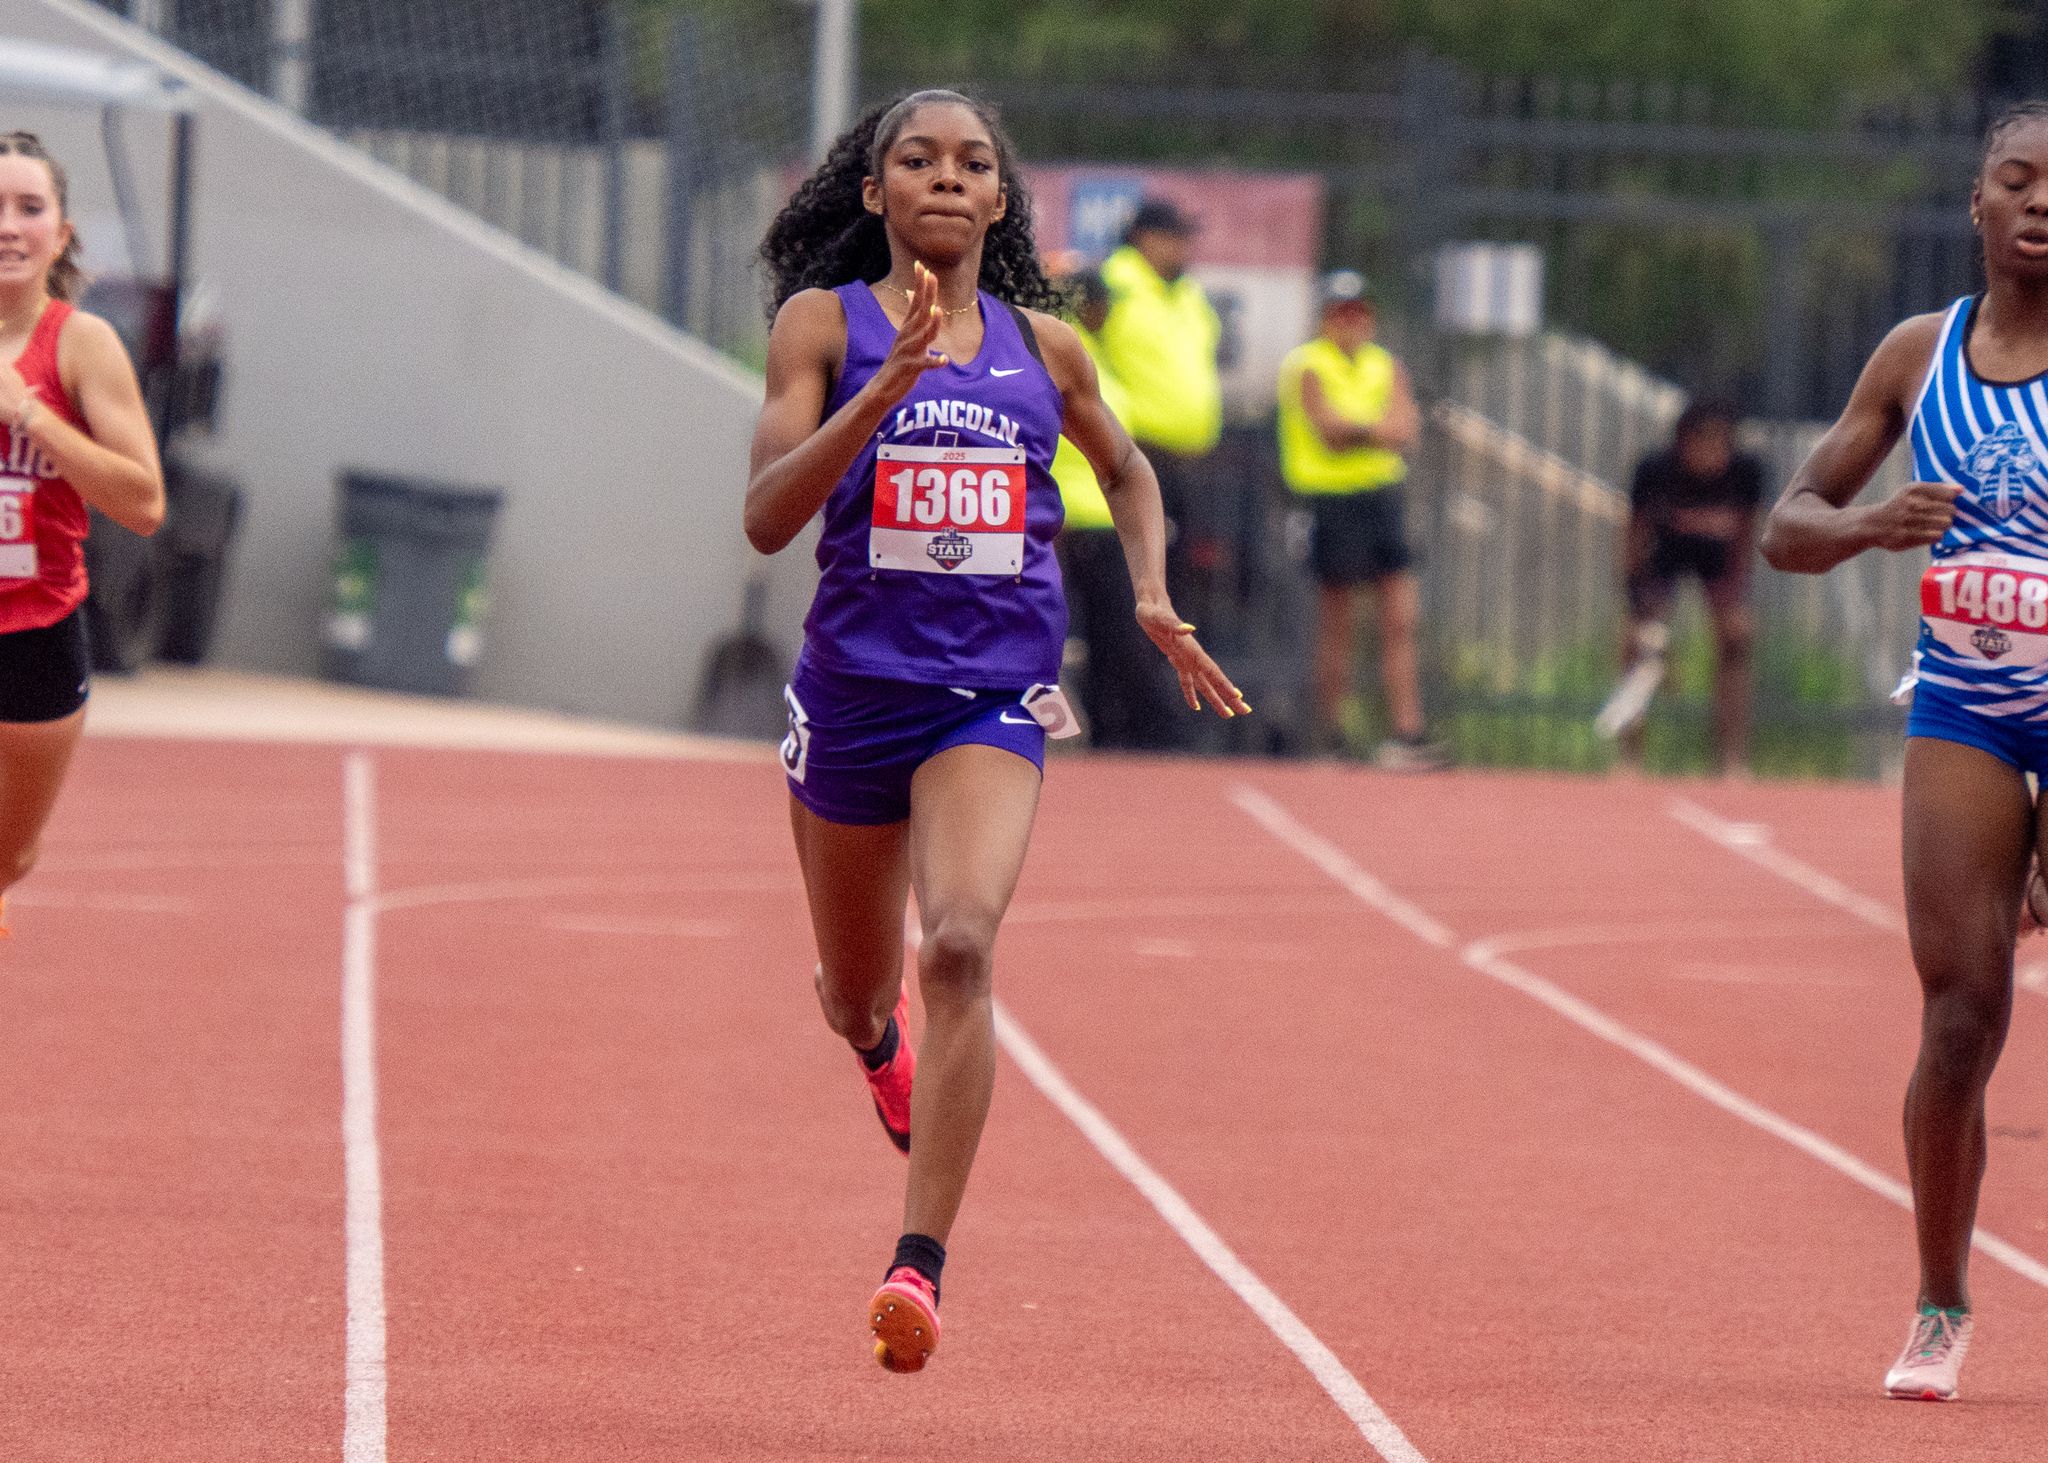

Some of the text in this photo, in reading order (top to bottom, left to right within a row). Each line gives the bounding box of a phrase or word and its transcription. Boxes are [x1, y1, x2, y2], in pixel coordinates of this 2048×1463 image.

[894, 399, 1020, 447] LINCOLN
[942, 452, 966, 461] 2025
[0, 496, 22, 539] 6
[889, 468, 1011, 526] 1366
[928, 544, 972, 556] STATE
[1934, 569, 2048, 629] 1488
